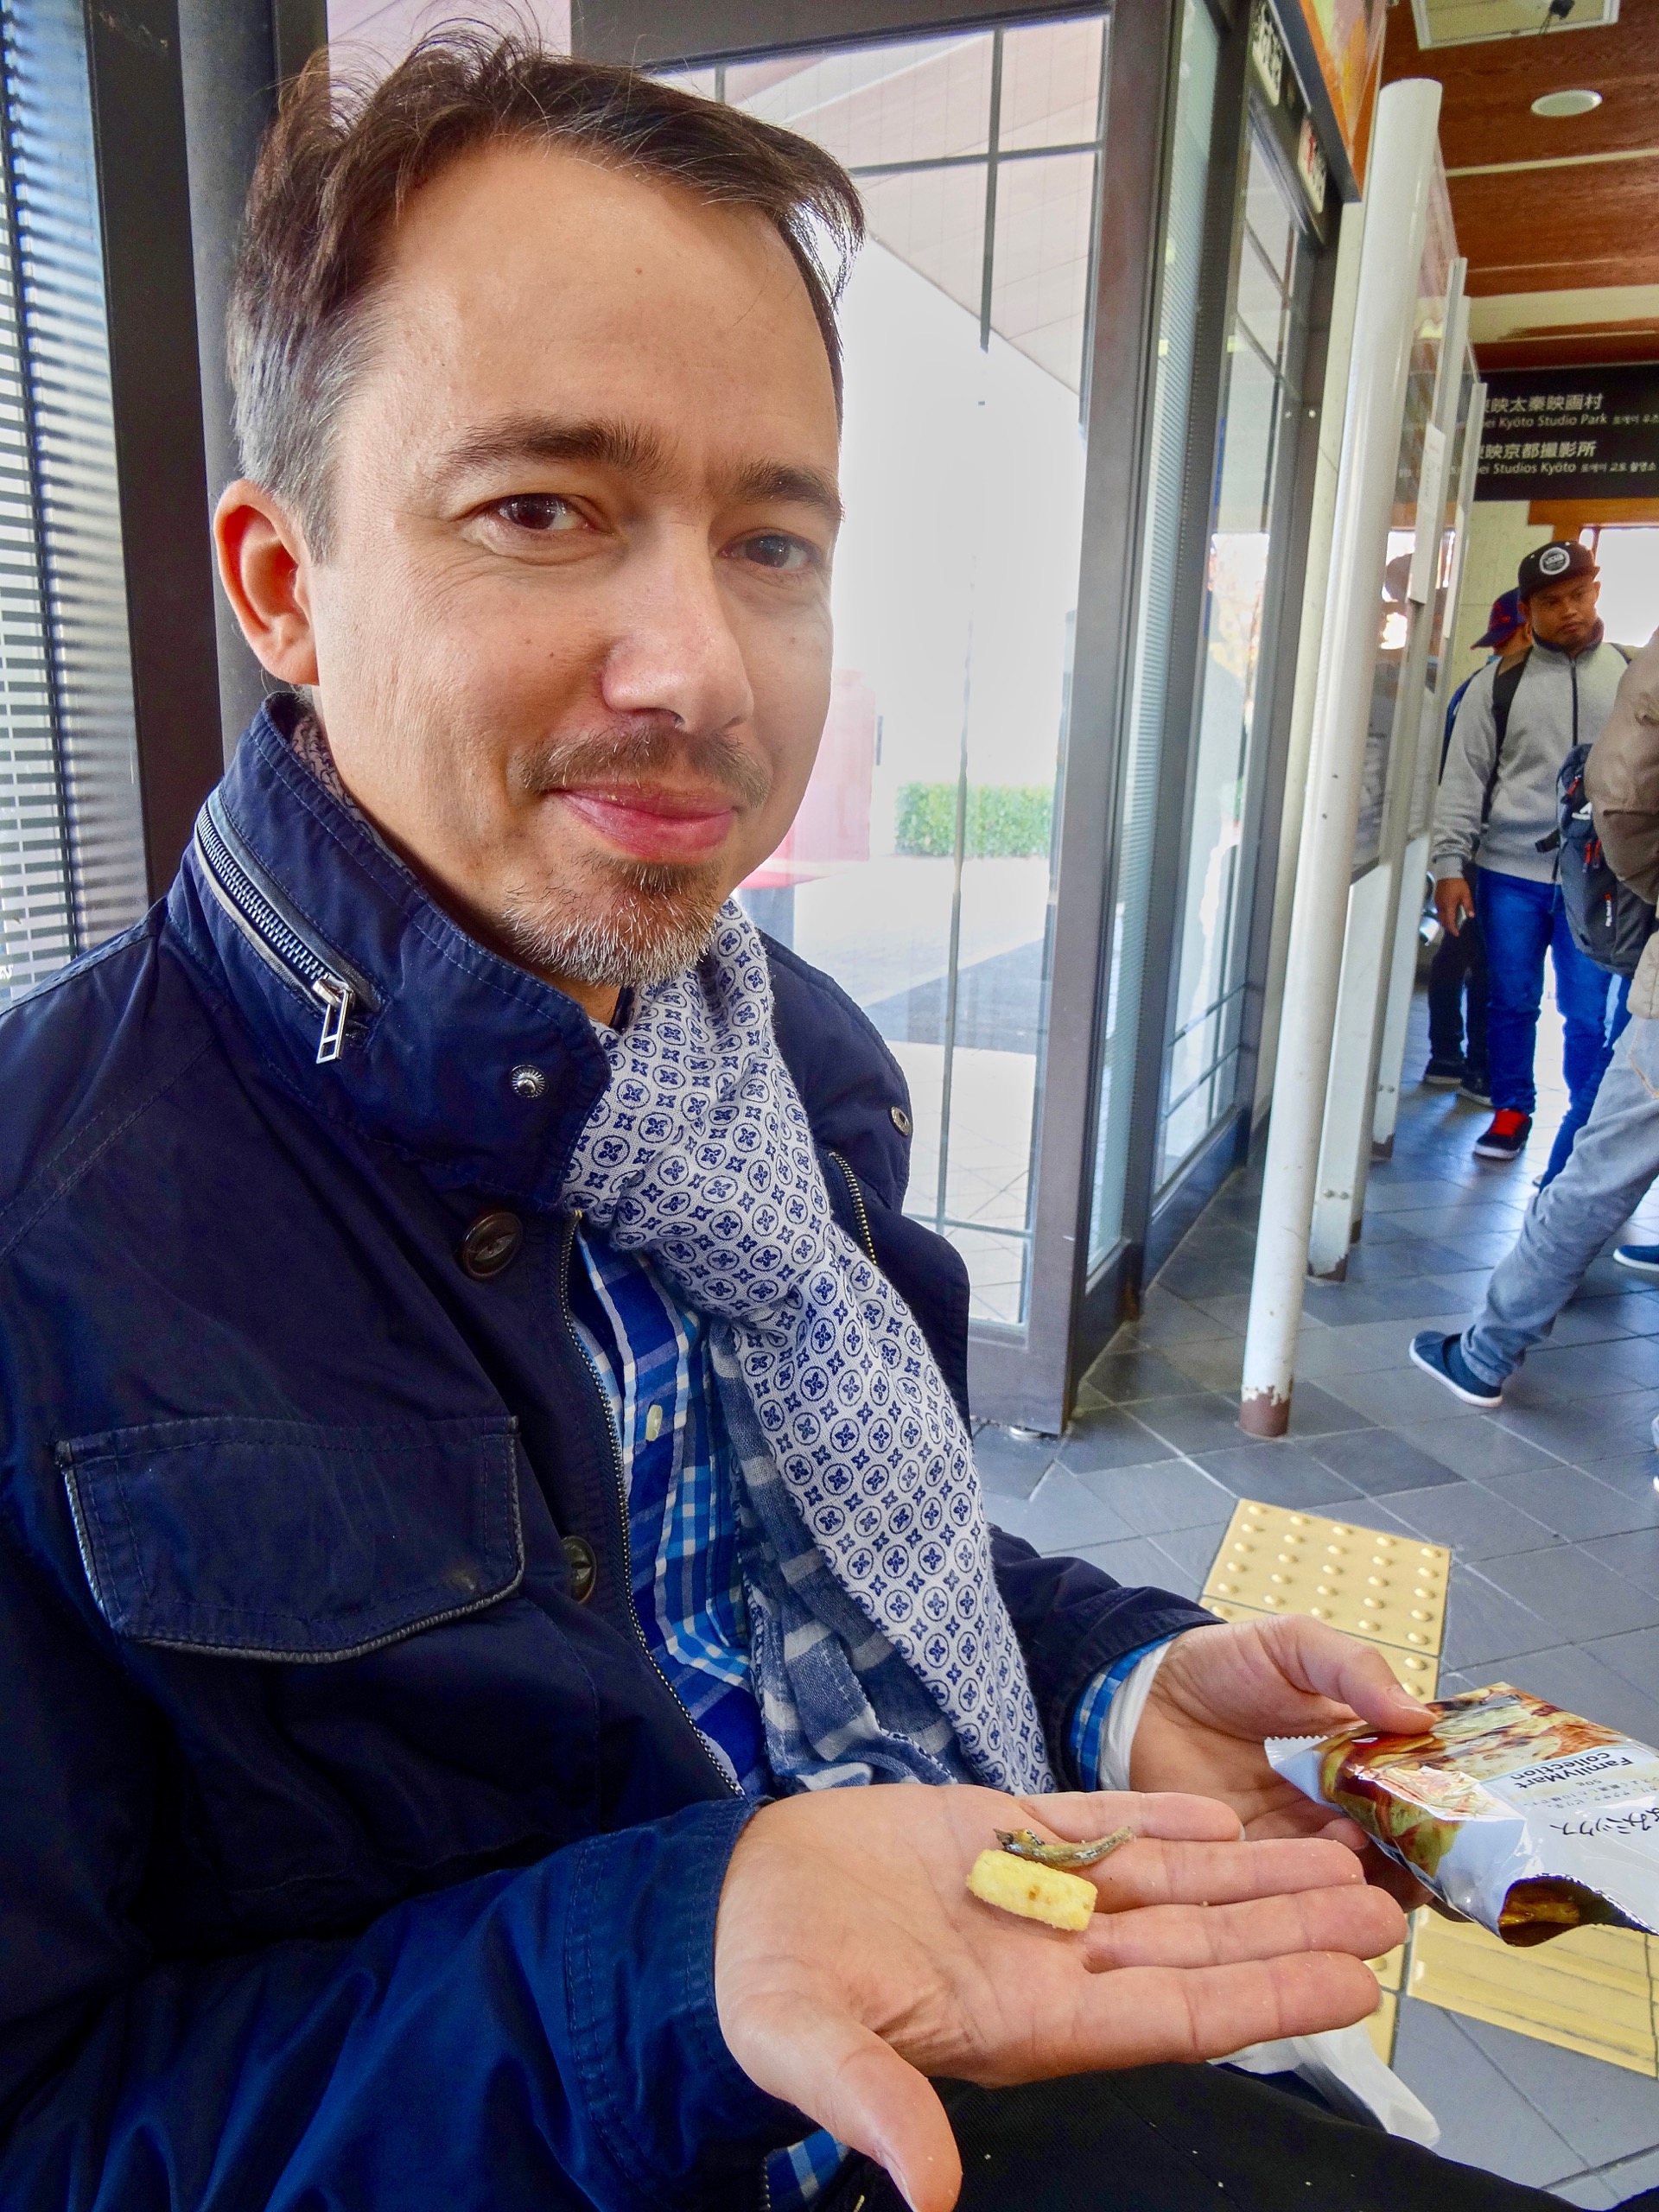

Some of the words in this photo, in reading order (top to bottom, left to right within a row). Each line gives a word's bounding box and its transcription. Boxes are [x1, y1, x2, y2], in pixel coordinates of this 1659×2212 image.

[1537, 414, 1578, 427] Studio
[1580, 412, 1607, 425] Park
[1492, 461, 1538, 475] Studios
[1510, 1752, 1611, 1780] collection
[1514, 1757, 1634, 1789] FamilyMart
